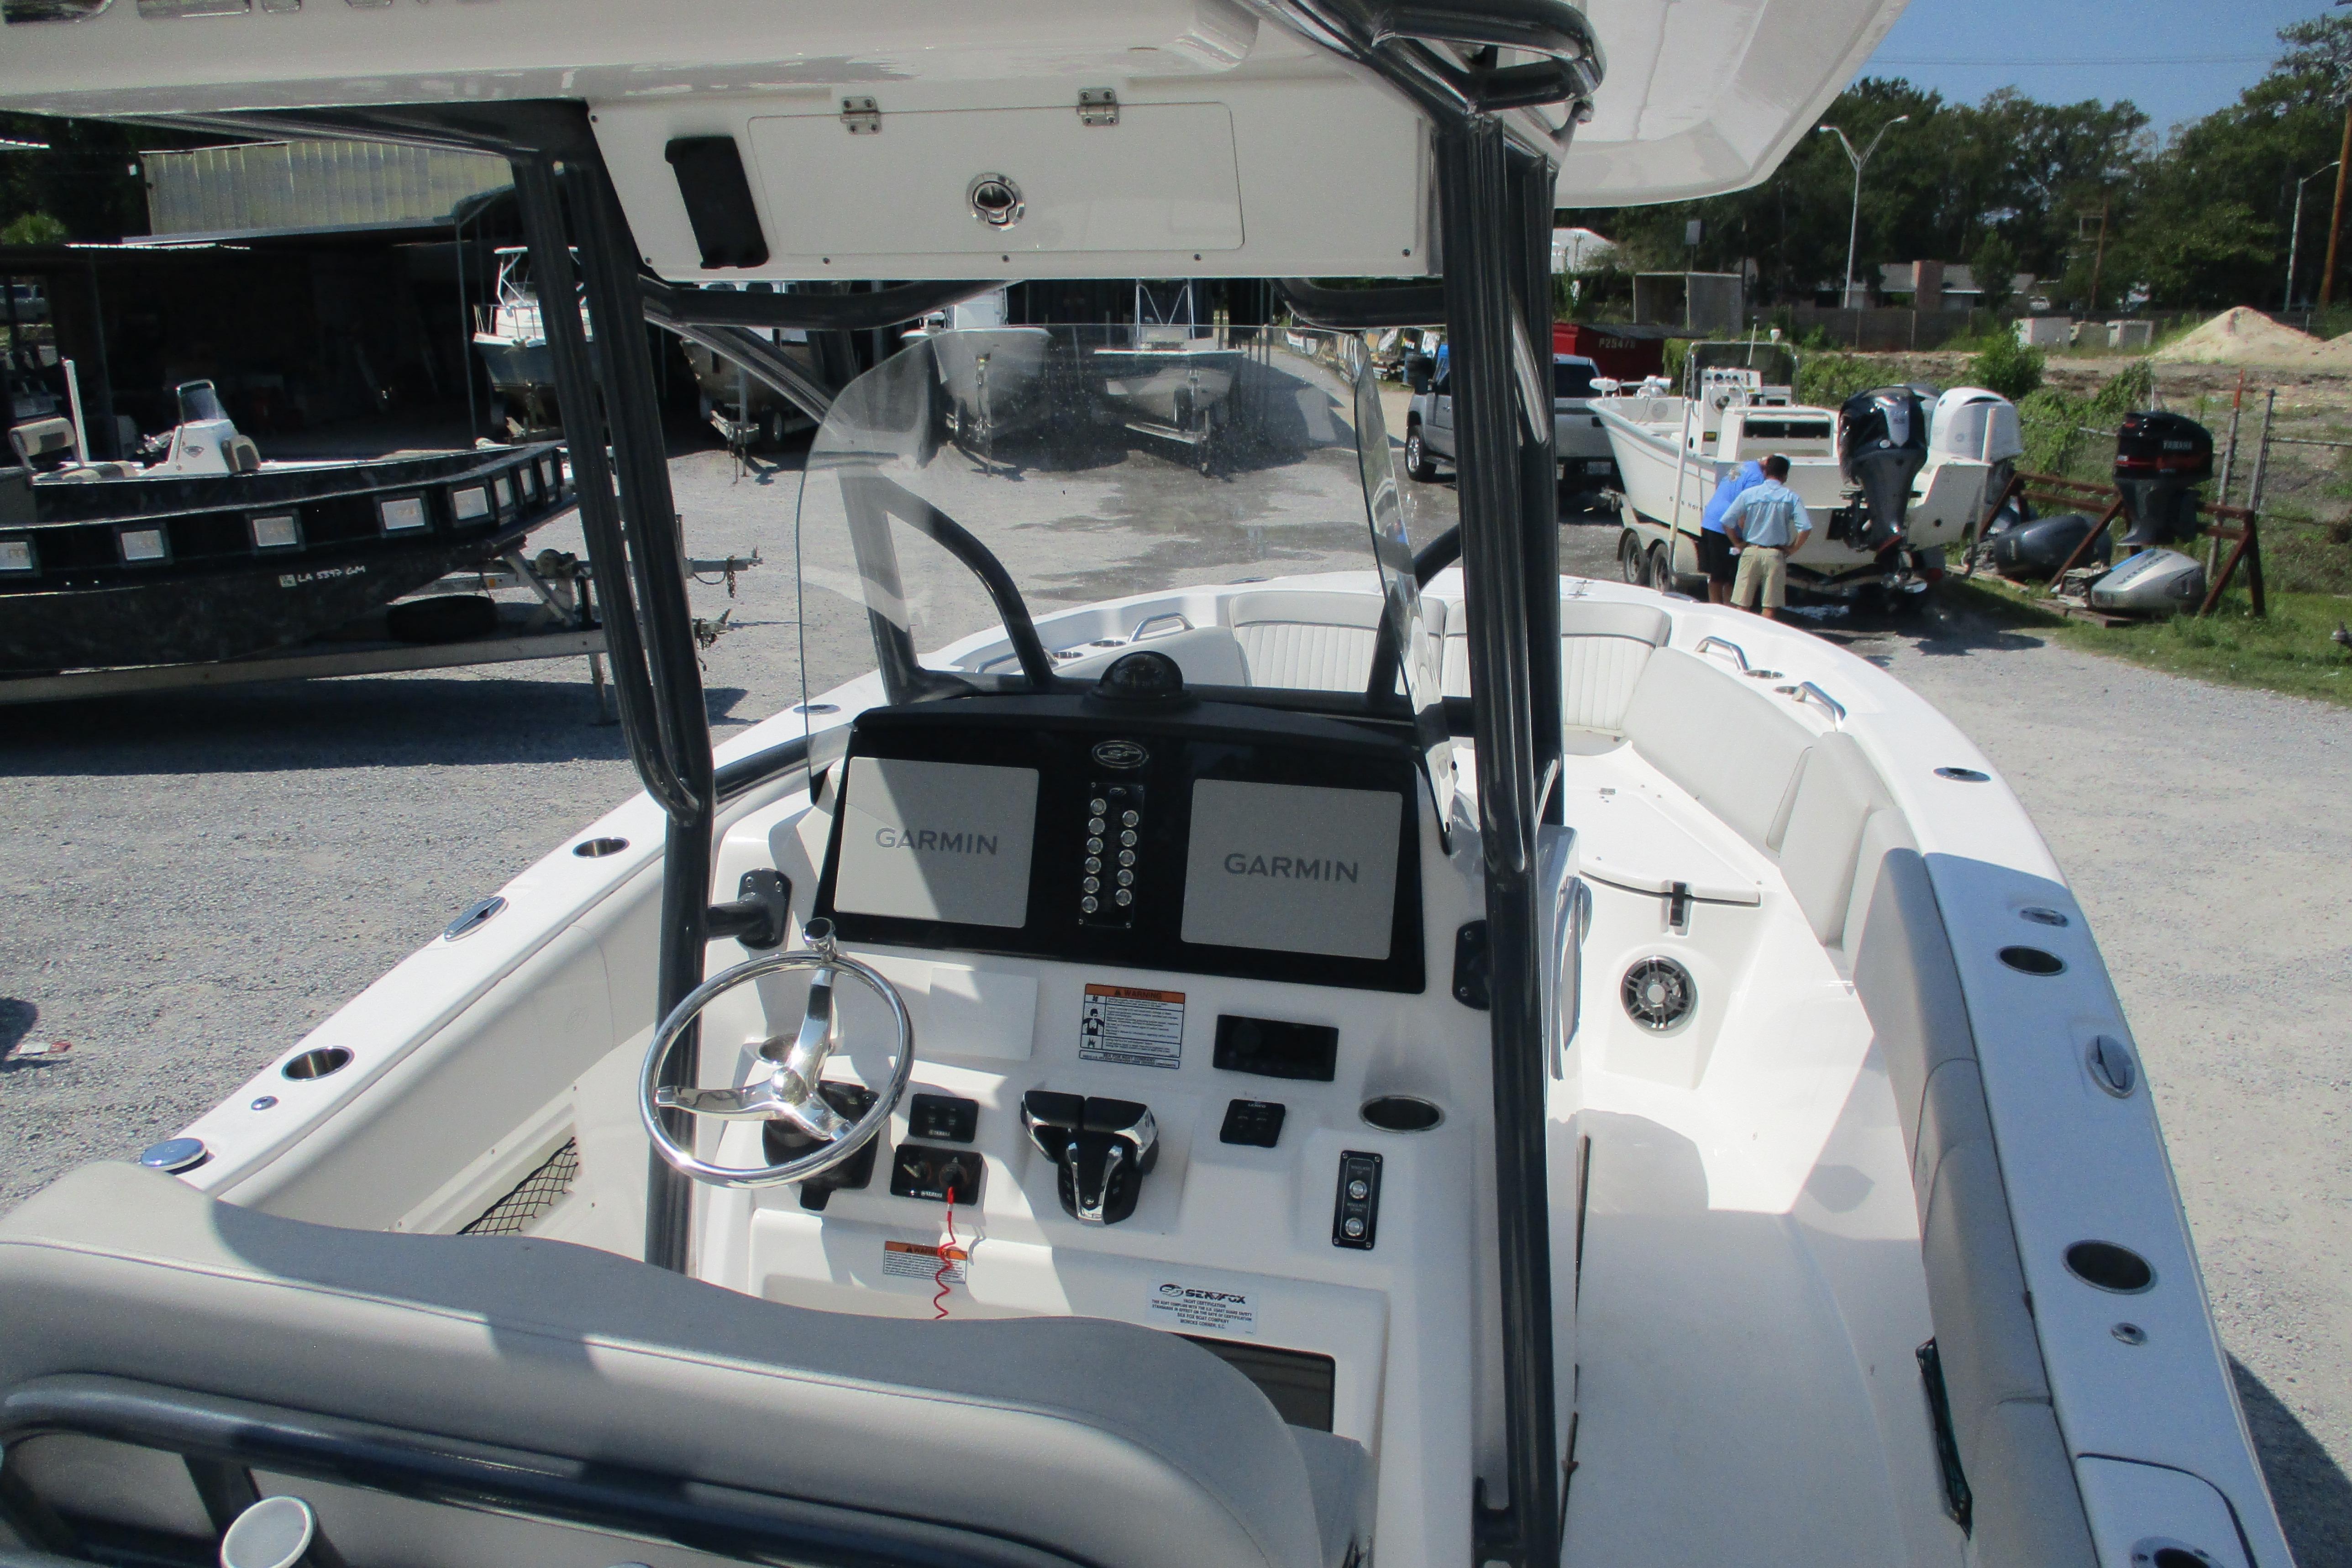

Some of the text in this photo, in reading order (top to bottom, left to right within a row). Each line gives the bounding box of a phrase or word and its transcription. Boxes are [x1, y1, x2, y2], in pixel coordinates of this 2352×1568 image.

[2163, 441, 2192, 450] YAMAHA
[297, 573, 313, 582] LA
[875, 828, 998, 855] GARMIN
[1224, 853, 1359, 883] GARMIN
[1124, 989, 1162, 1000] WARNING
[1197, 1300, 1226, 1308] CERTIFICATION
